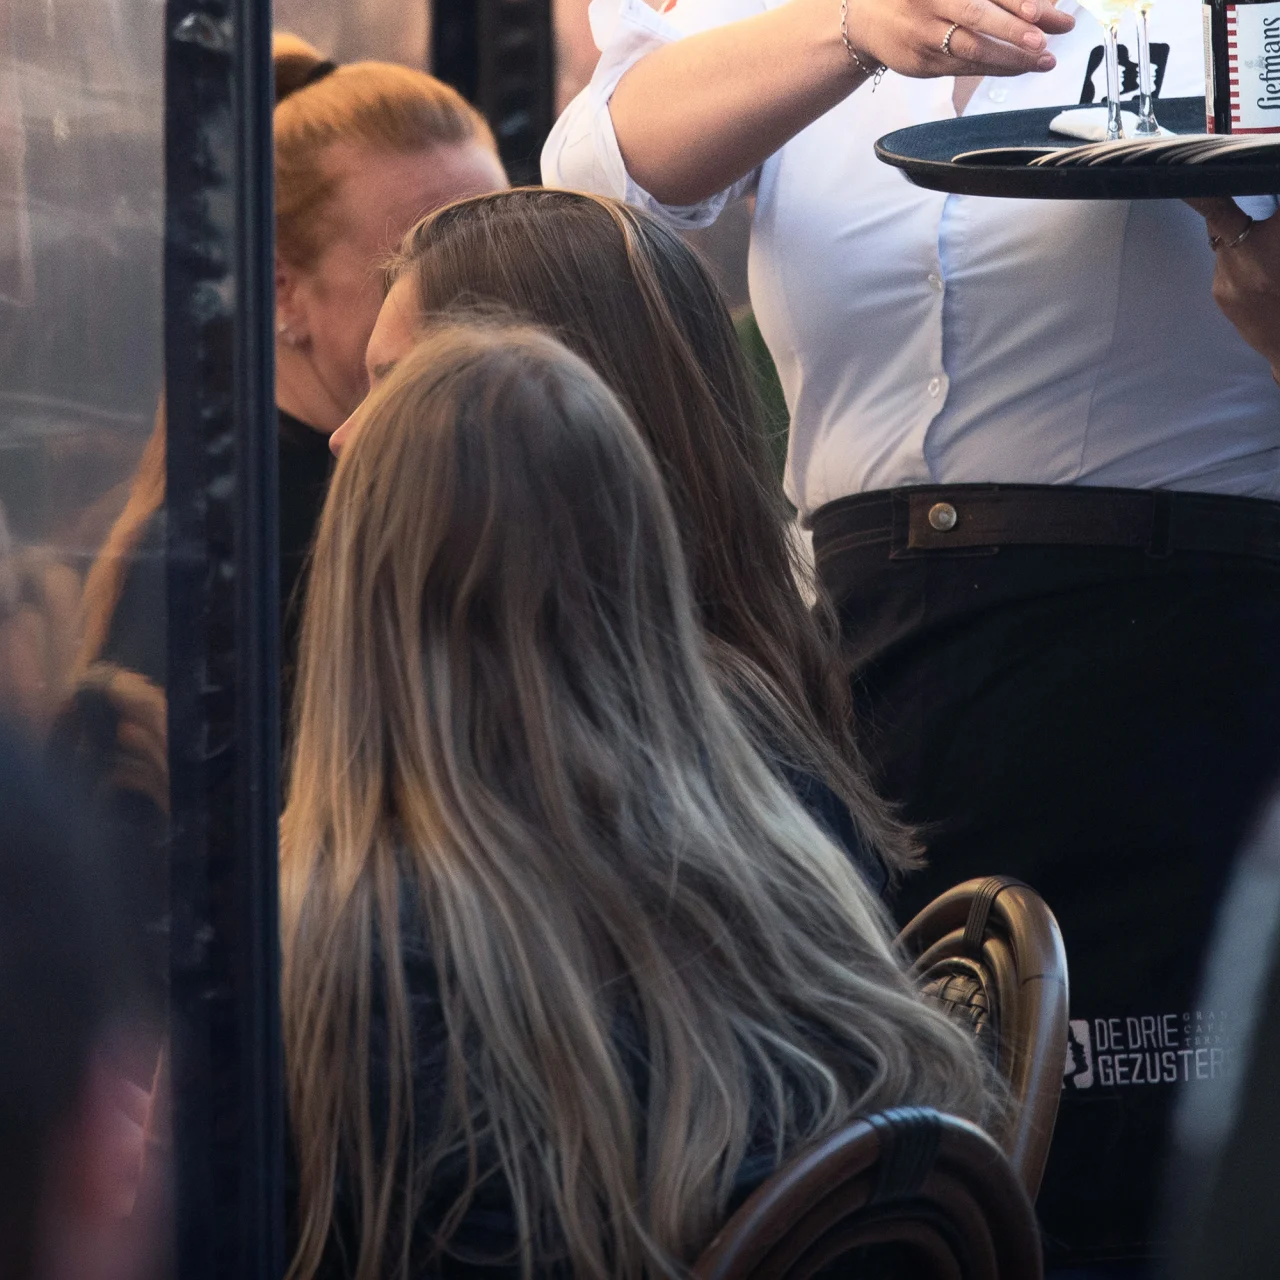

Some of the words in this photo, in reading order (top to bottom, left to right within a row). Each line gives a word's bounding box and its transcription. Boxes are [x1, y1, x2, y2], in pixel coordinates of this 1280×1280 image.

[1095, 1018, 1124, 1051] DE
[1126, 1014, 1179, 1049] DRIE
[1098, 1048, 1226, 1086] GEZUSTER
